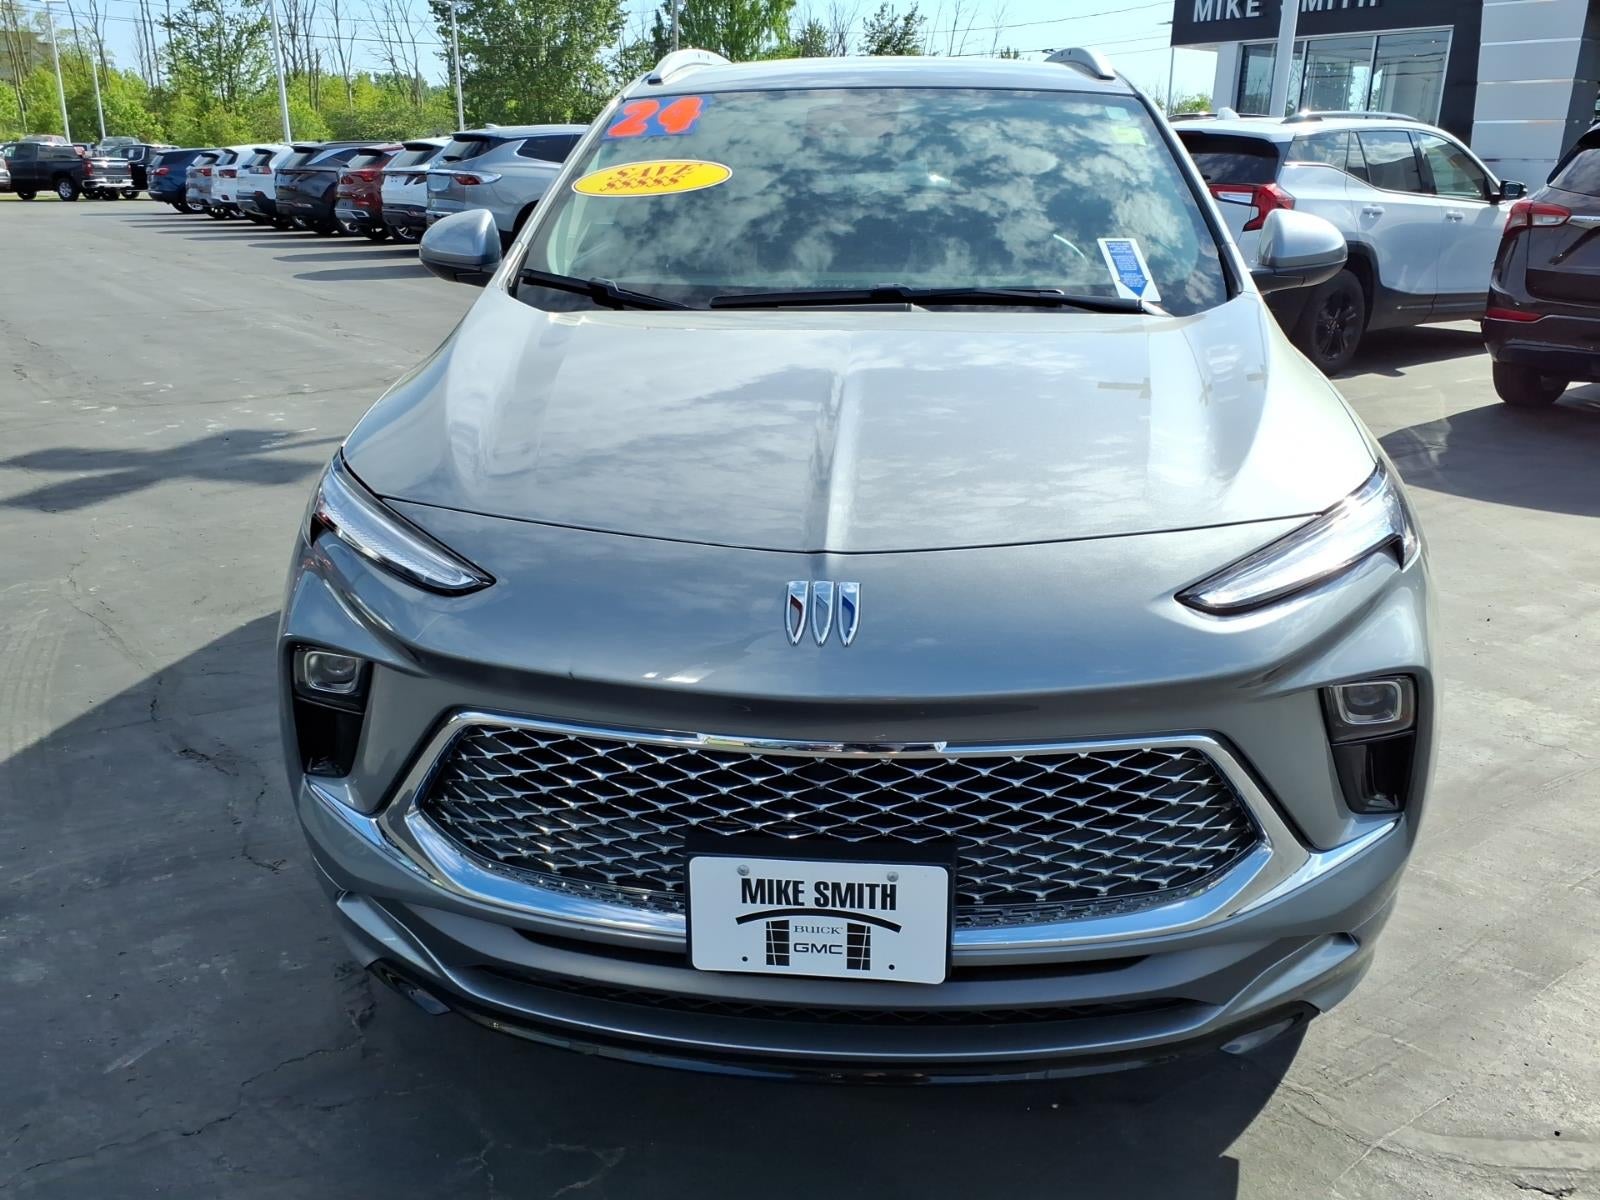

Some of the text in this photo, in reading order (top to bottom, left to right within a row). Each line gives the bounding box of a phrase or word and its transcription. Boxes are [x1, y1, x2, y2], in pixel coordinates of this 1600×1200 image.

[1193, 0, 1260, 23] MIKE
[607, 96, 704, 137] 24
[741, 878, 897, 911] MIKE SMITH
[794, 925, 842, 935] BUICK
[793, 942, 843, 955] GMC
